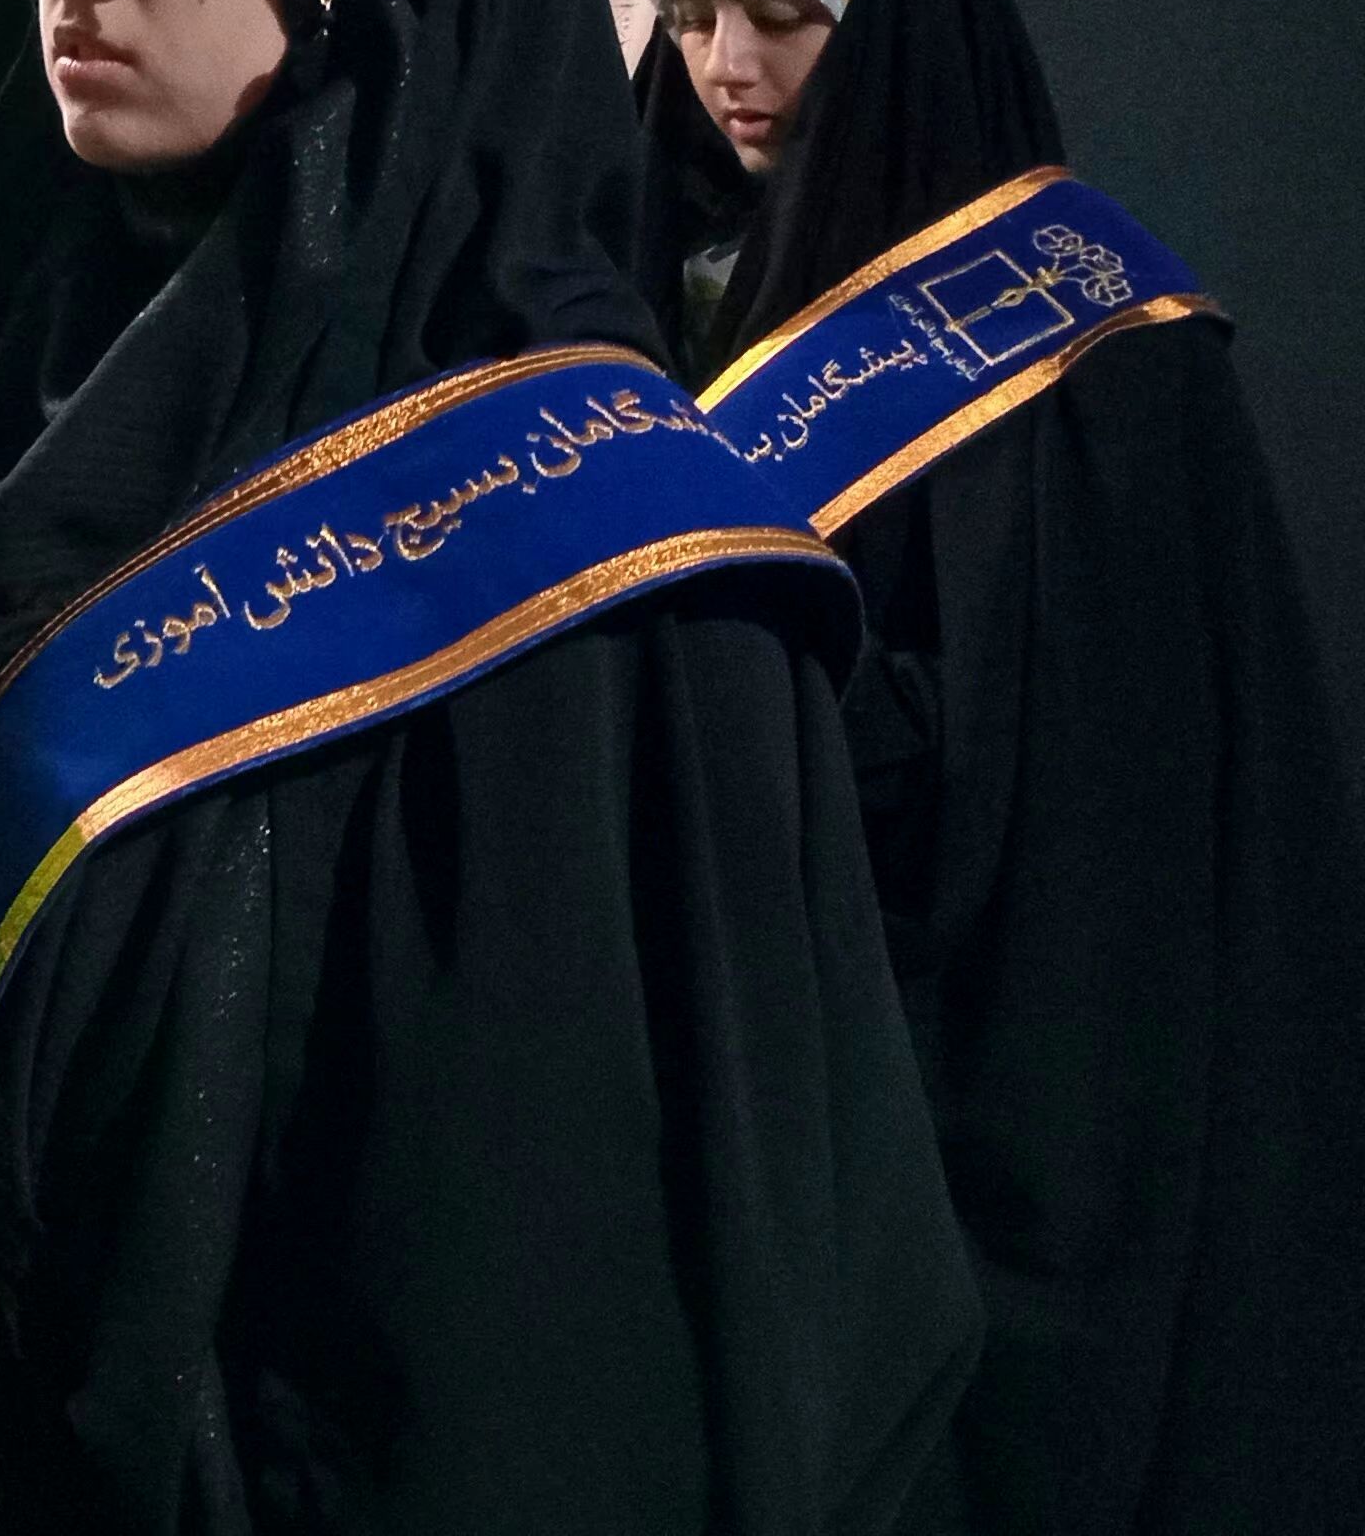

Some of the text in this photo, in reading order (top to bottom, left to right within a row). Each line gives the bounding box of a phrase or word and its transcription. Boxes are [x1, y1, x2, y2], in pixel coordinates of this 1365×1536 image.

[777, 339, 928, 449] پیشگامان
[382, 454, 537, 561] بسیج
[94, 563, 231, 689] آموزی
[245, 523, 383, 630] دانش
